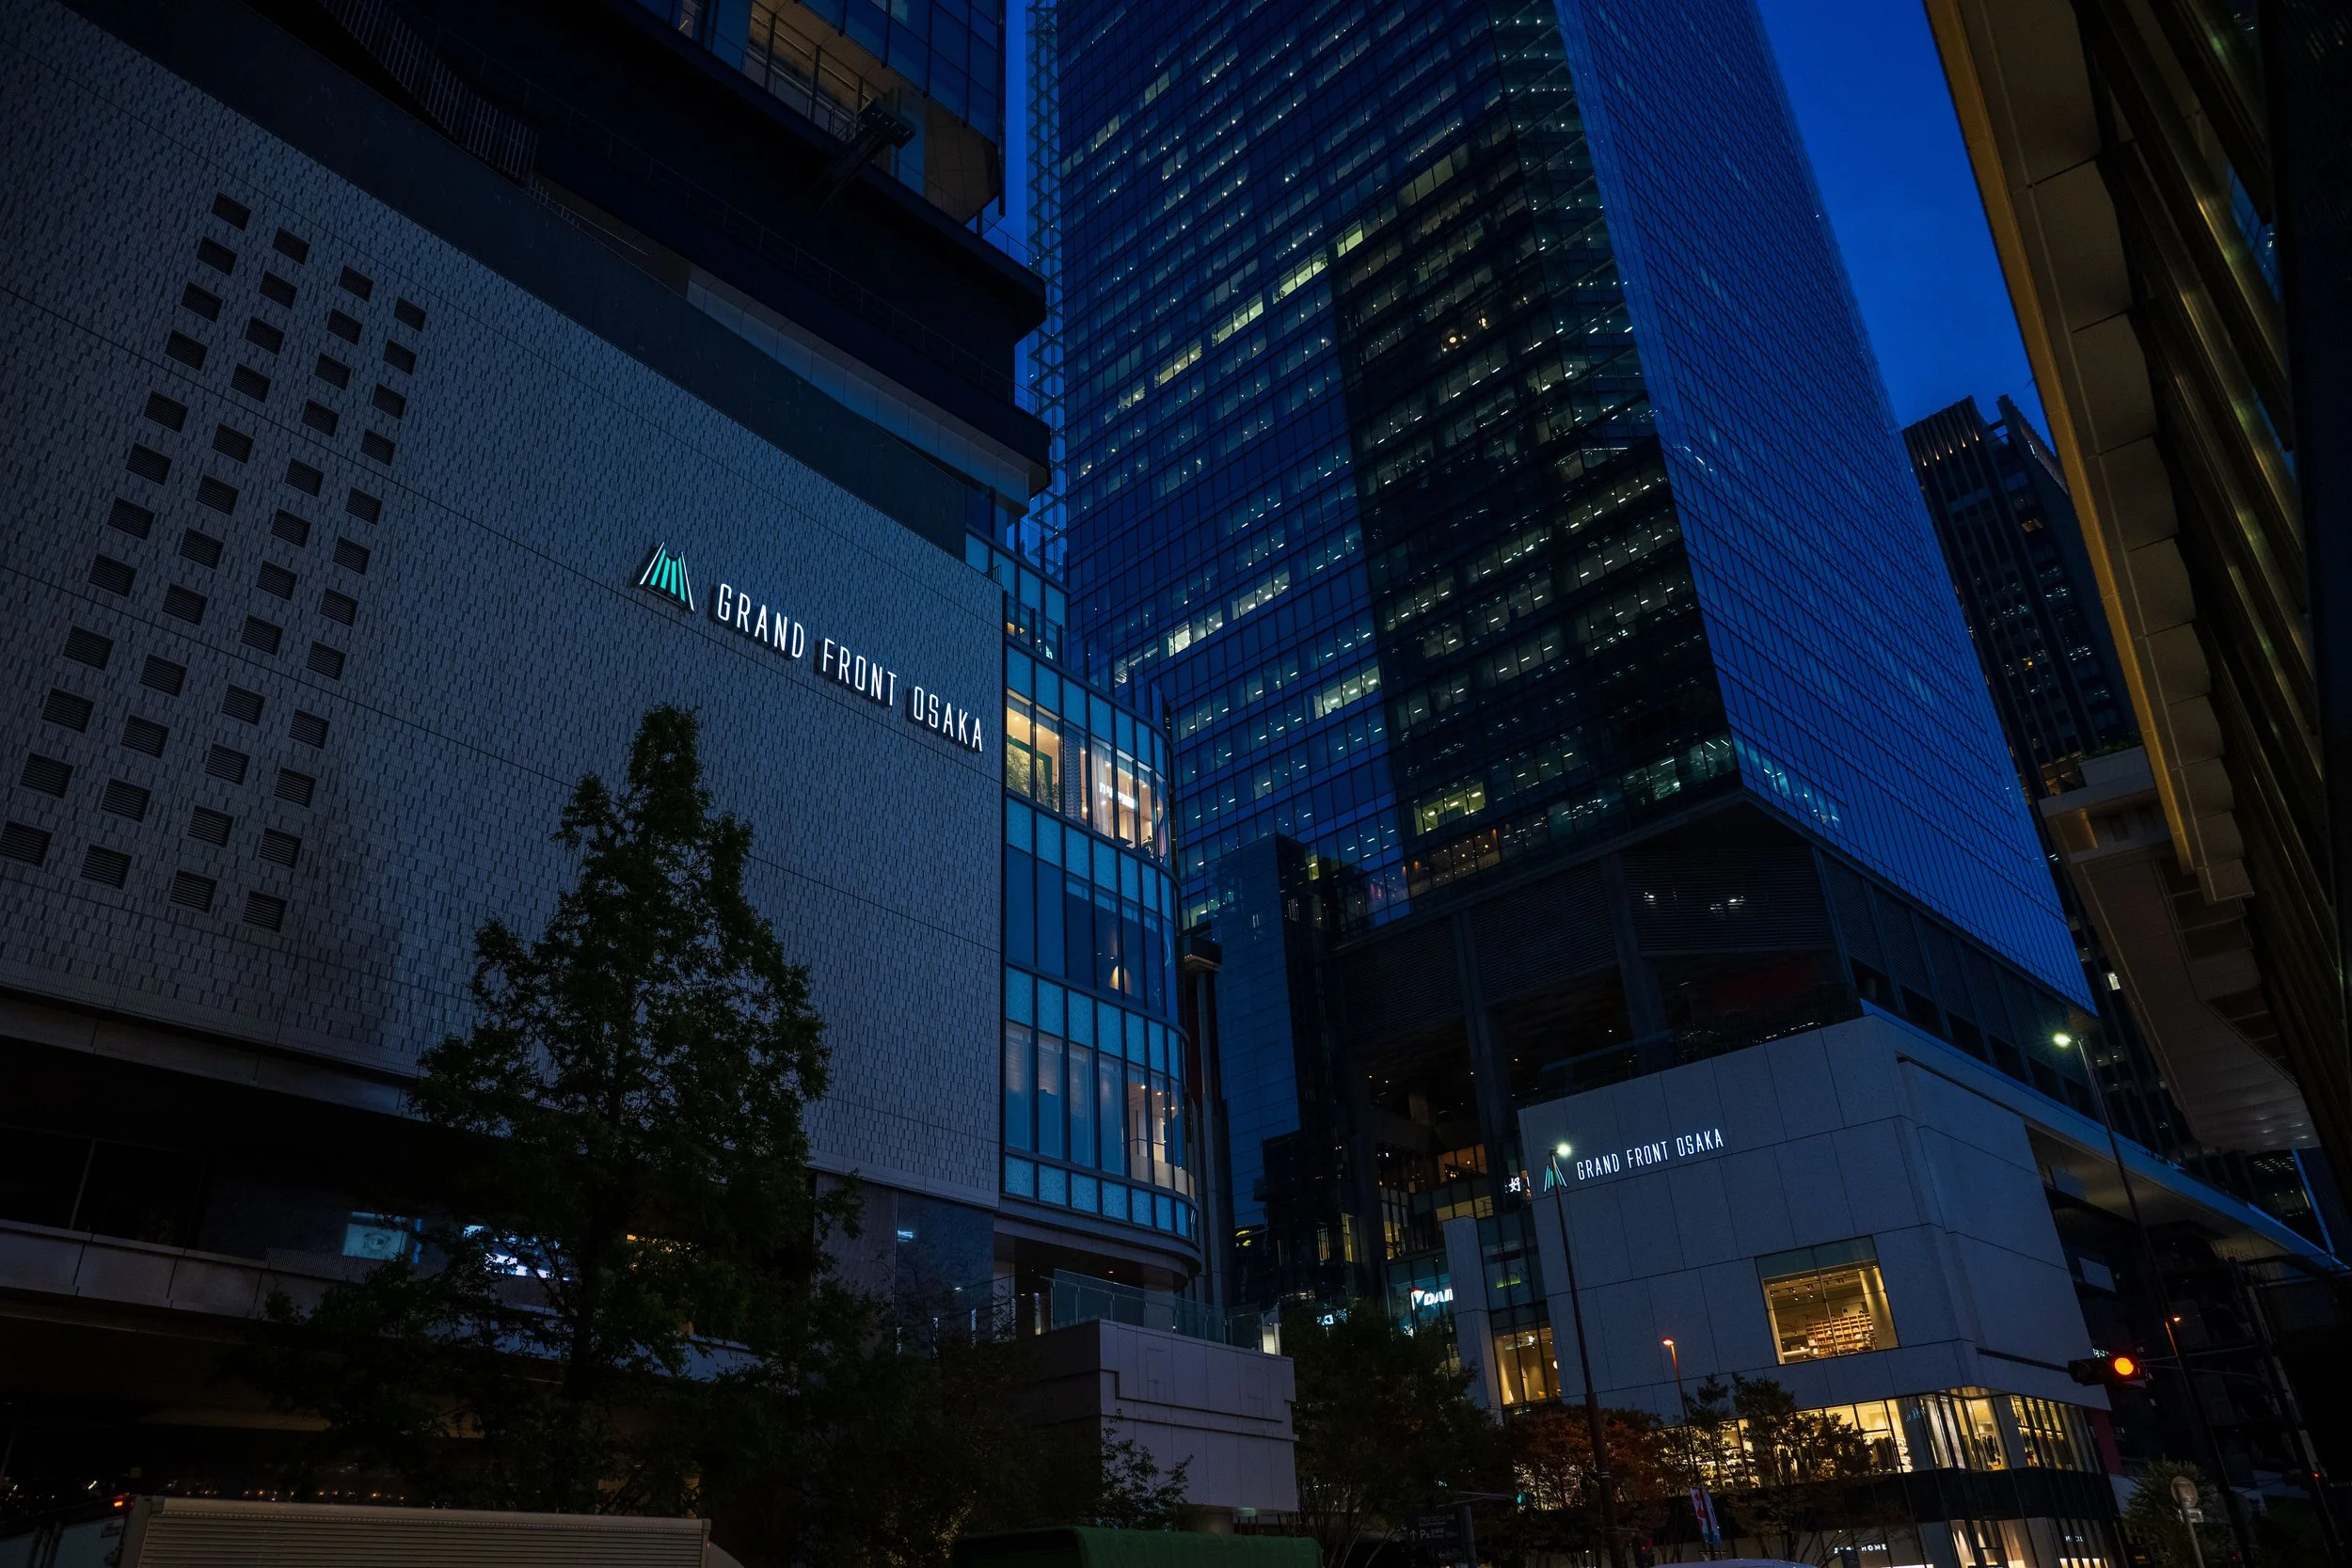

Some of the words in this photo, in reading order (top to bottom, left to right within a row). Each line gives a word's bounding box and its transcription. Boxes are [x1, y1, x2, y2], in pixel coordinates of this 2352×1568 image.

[717, 583, 804, 658] GRAND
[822, 638, 898, 706] FRONT
[914, 686, 983, 752] OSAKA
[1576, 1153, 1621, 1181] GRAND
[1626, 1140, 1670, 1169] FRONT
[1676, 1128, 1724, 1157] OSAKA
